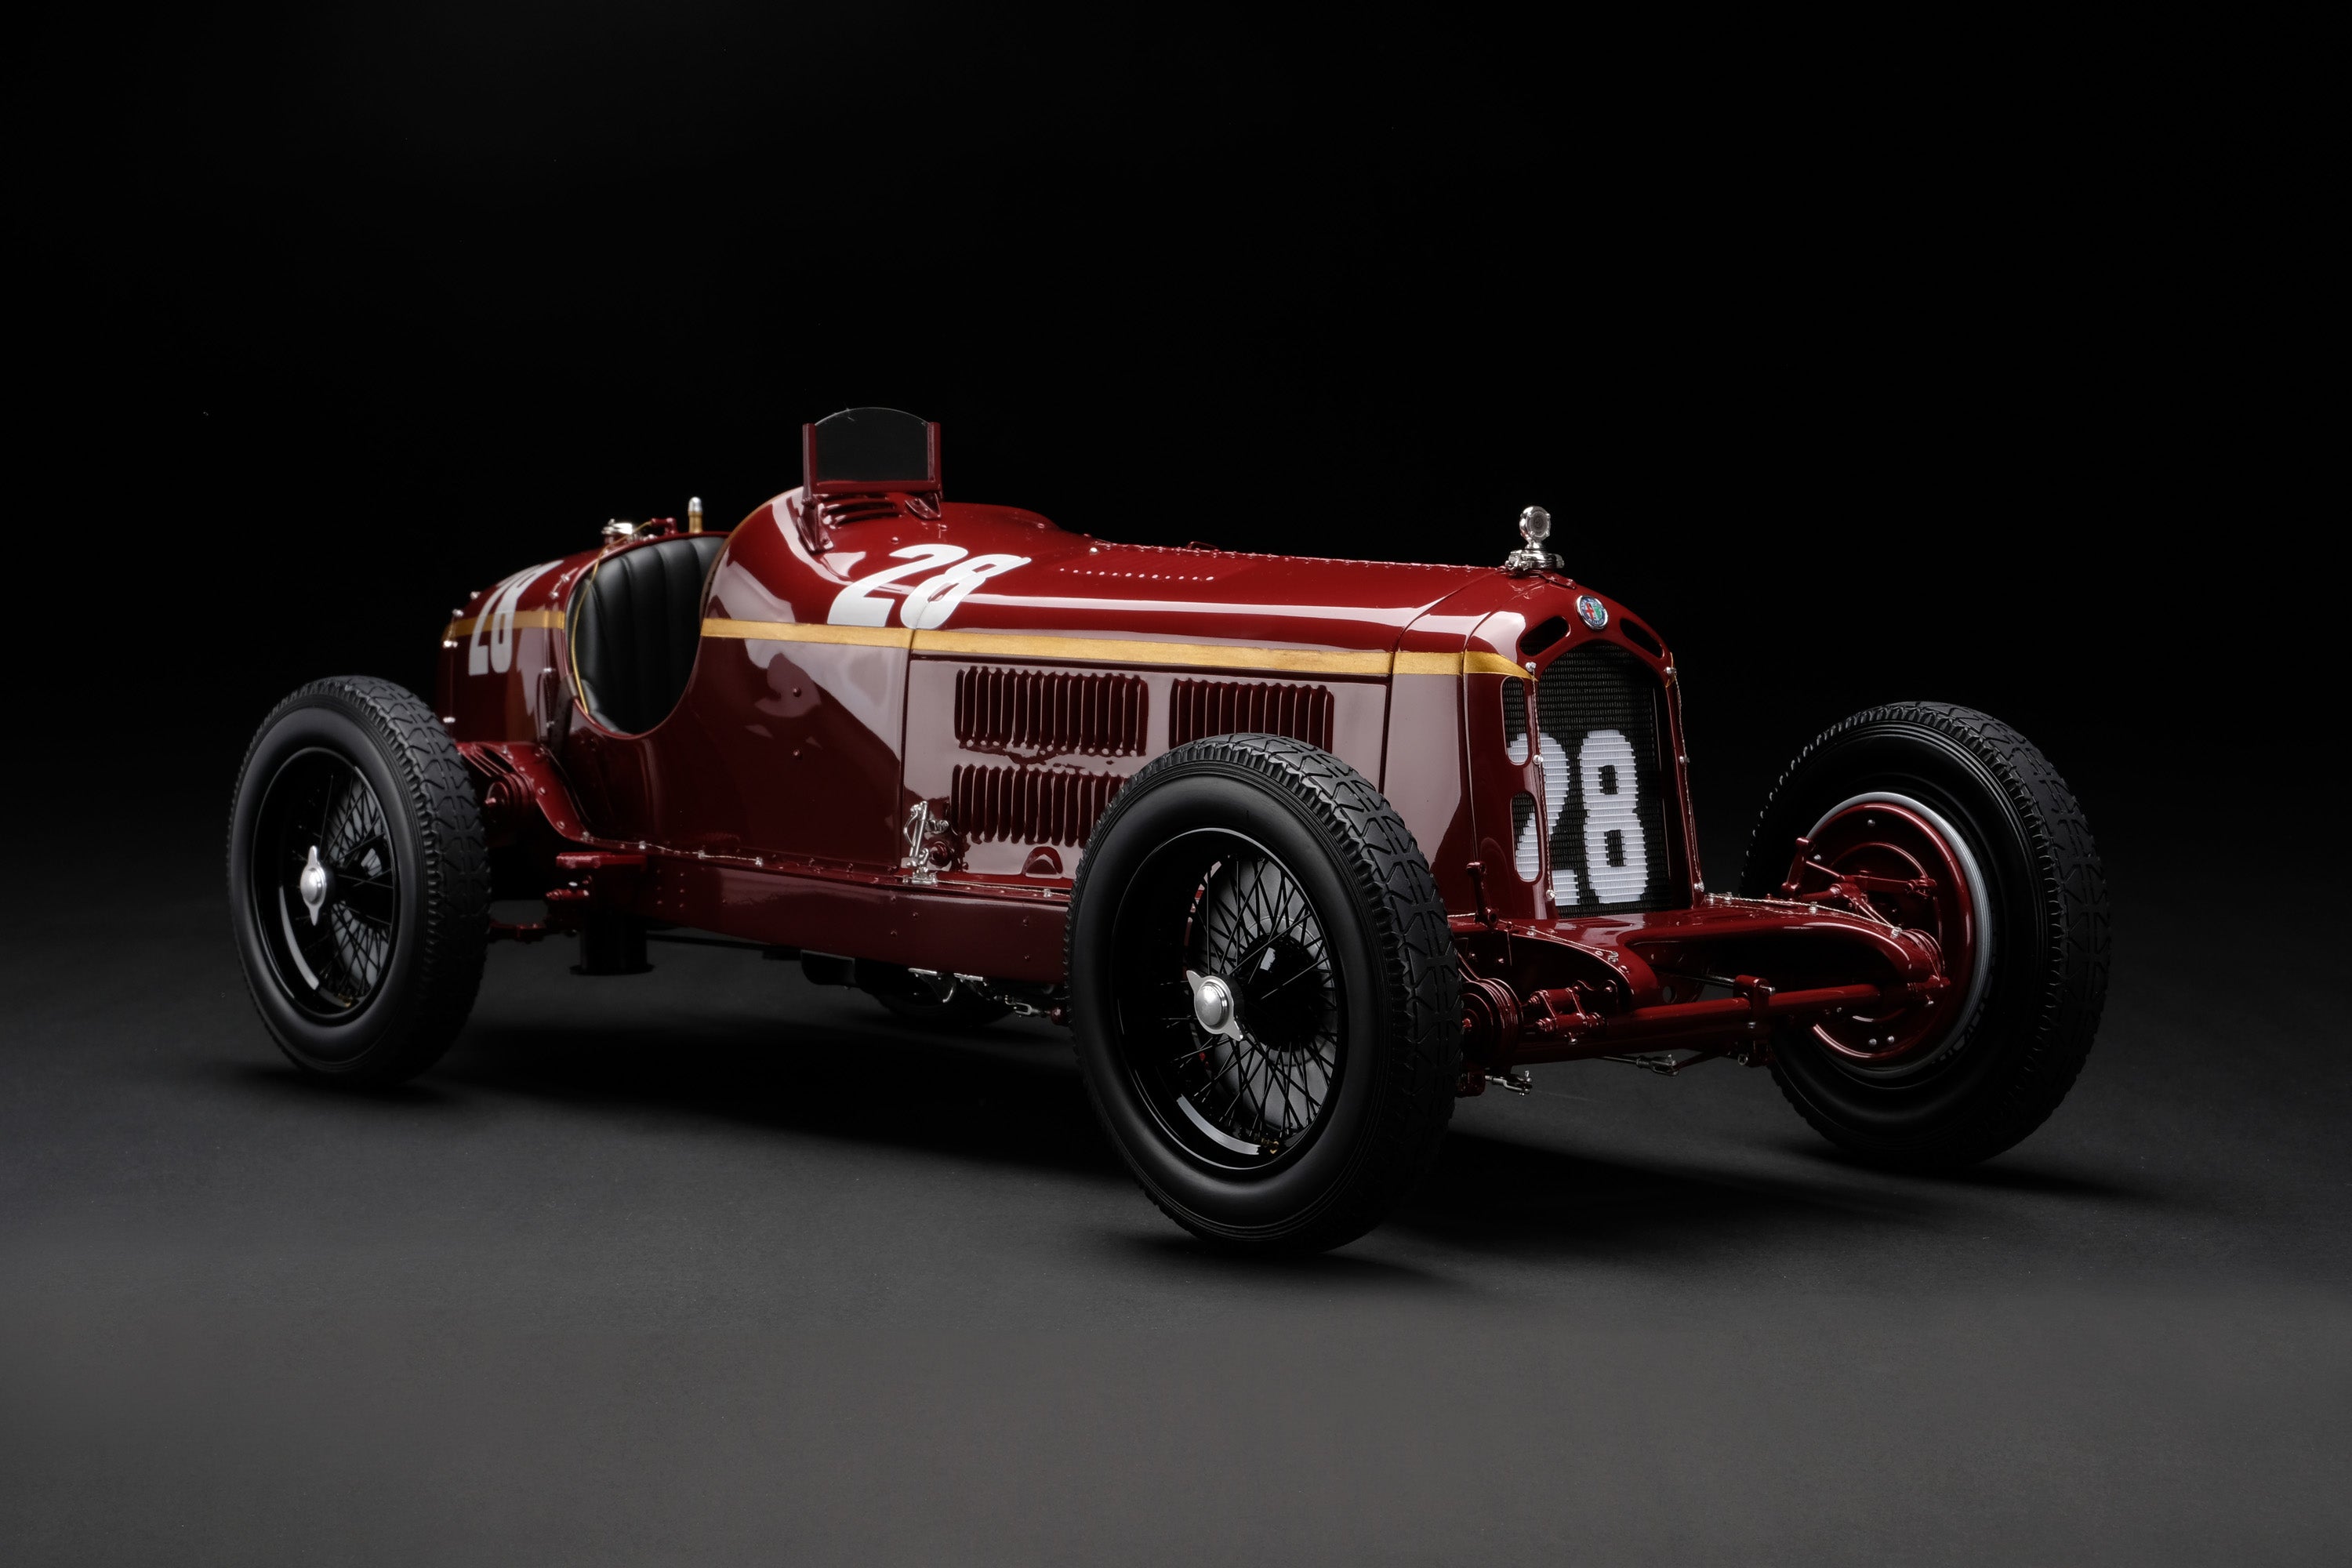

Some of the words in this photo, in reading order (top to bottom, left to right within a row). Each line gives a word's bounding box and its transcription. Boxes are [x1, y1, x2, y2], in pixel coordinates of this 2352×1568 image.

[469, 560, 564, 675] 28
[827, 543, 1032, 630] 28
[1508, 729, 1648, 906] 28
